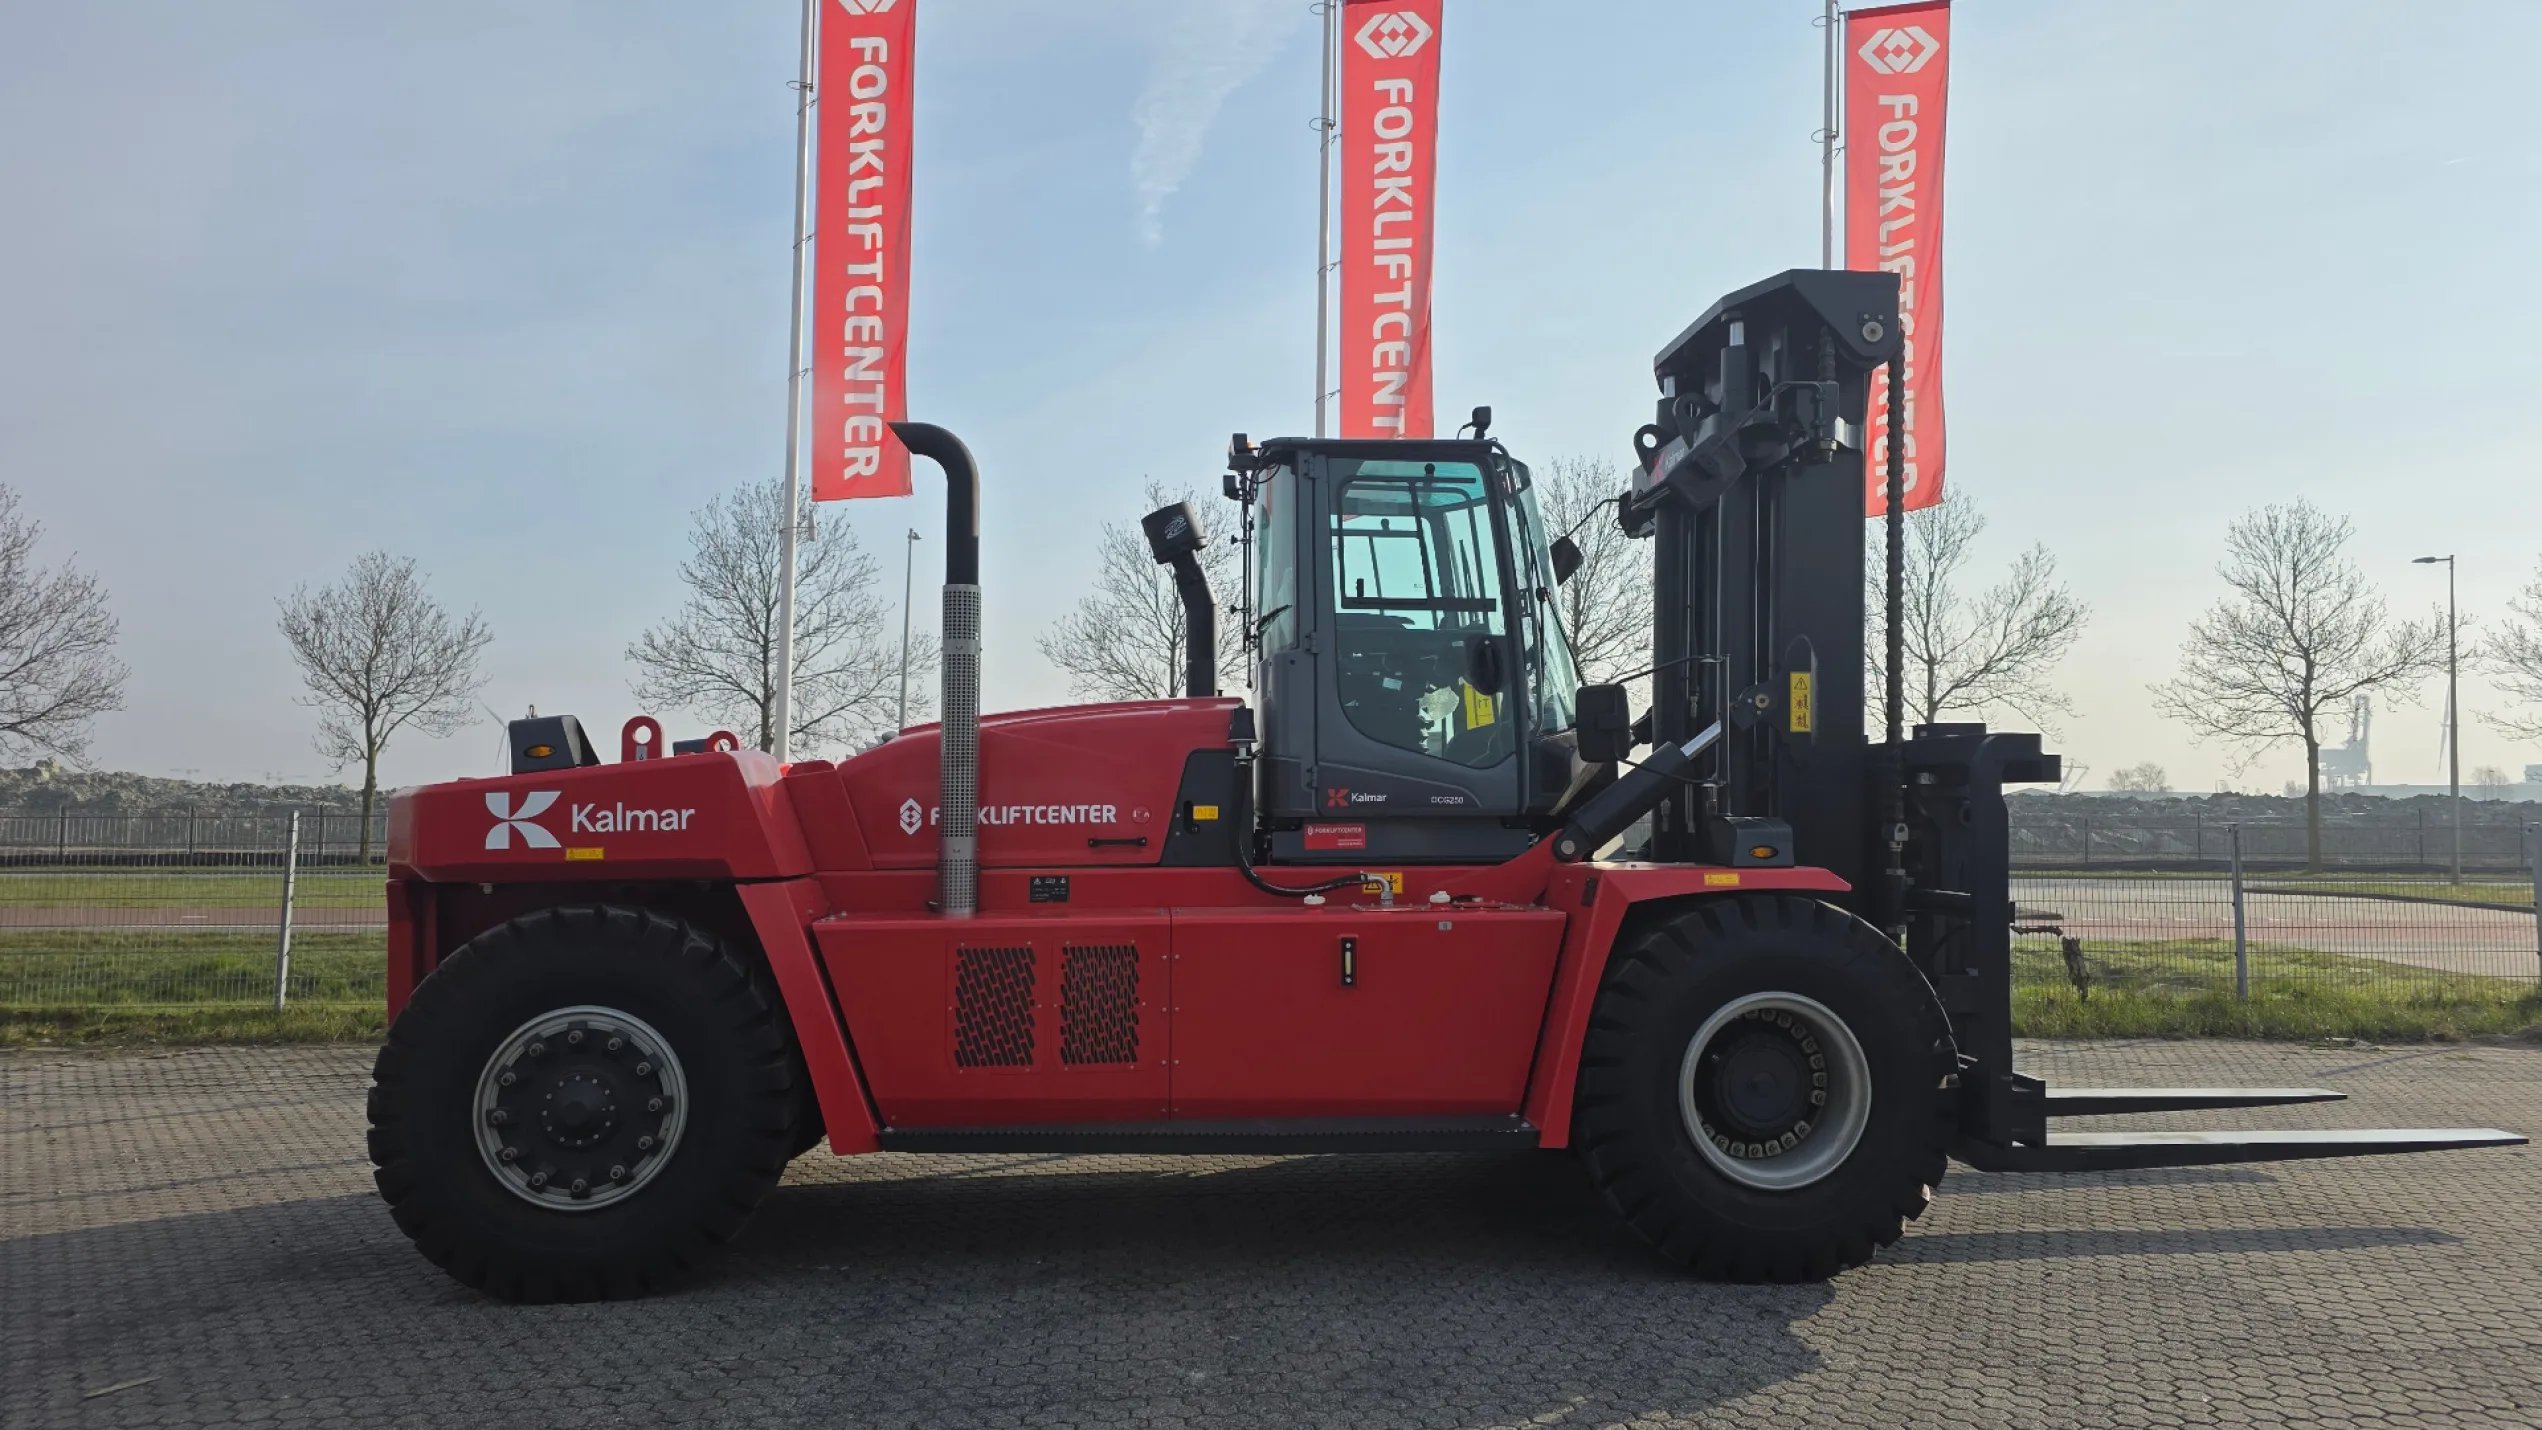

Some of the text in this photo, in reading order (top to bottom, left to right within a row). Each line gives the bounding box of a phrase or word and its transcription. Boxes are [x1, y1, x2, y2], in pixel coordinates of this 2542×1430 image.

[843, 36, 888, 481] FORKLIFTCENTER
[1372, 78, 1414, 438] FORKLIFTCENT
[1351, 792, 1387, 802] Kalmar
[571, 802, 696, 833] Kalmar
[930, 804, 1117, 825] FKLIFTCENTER
